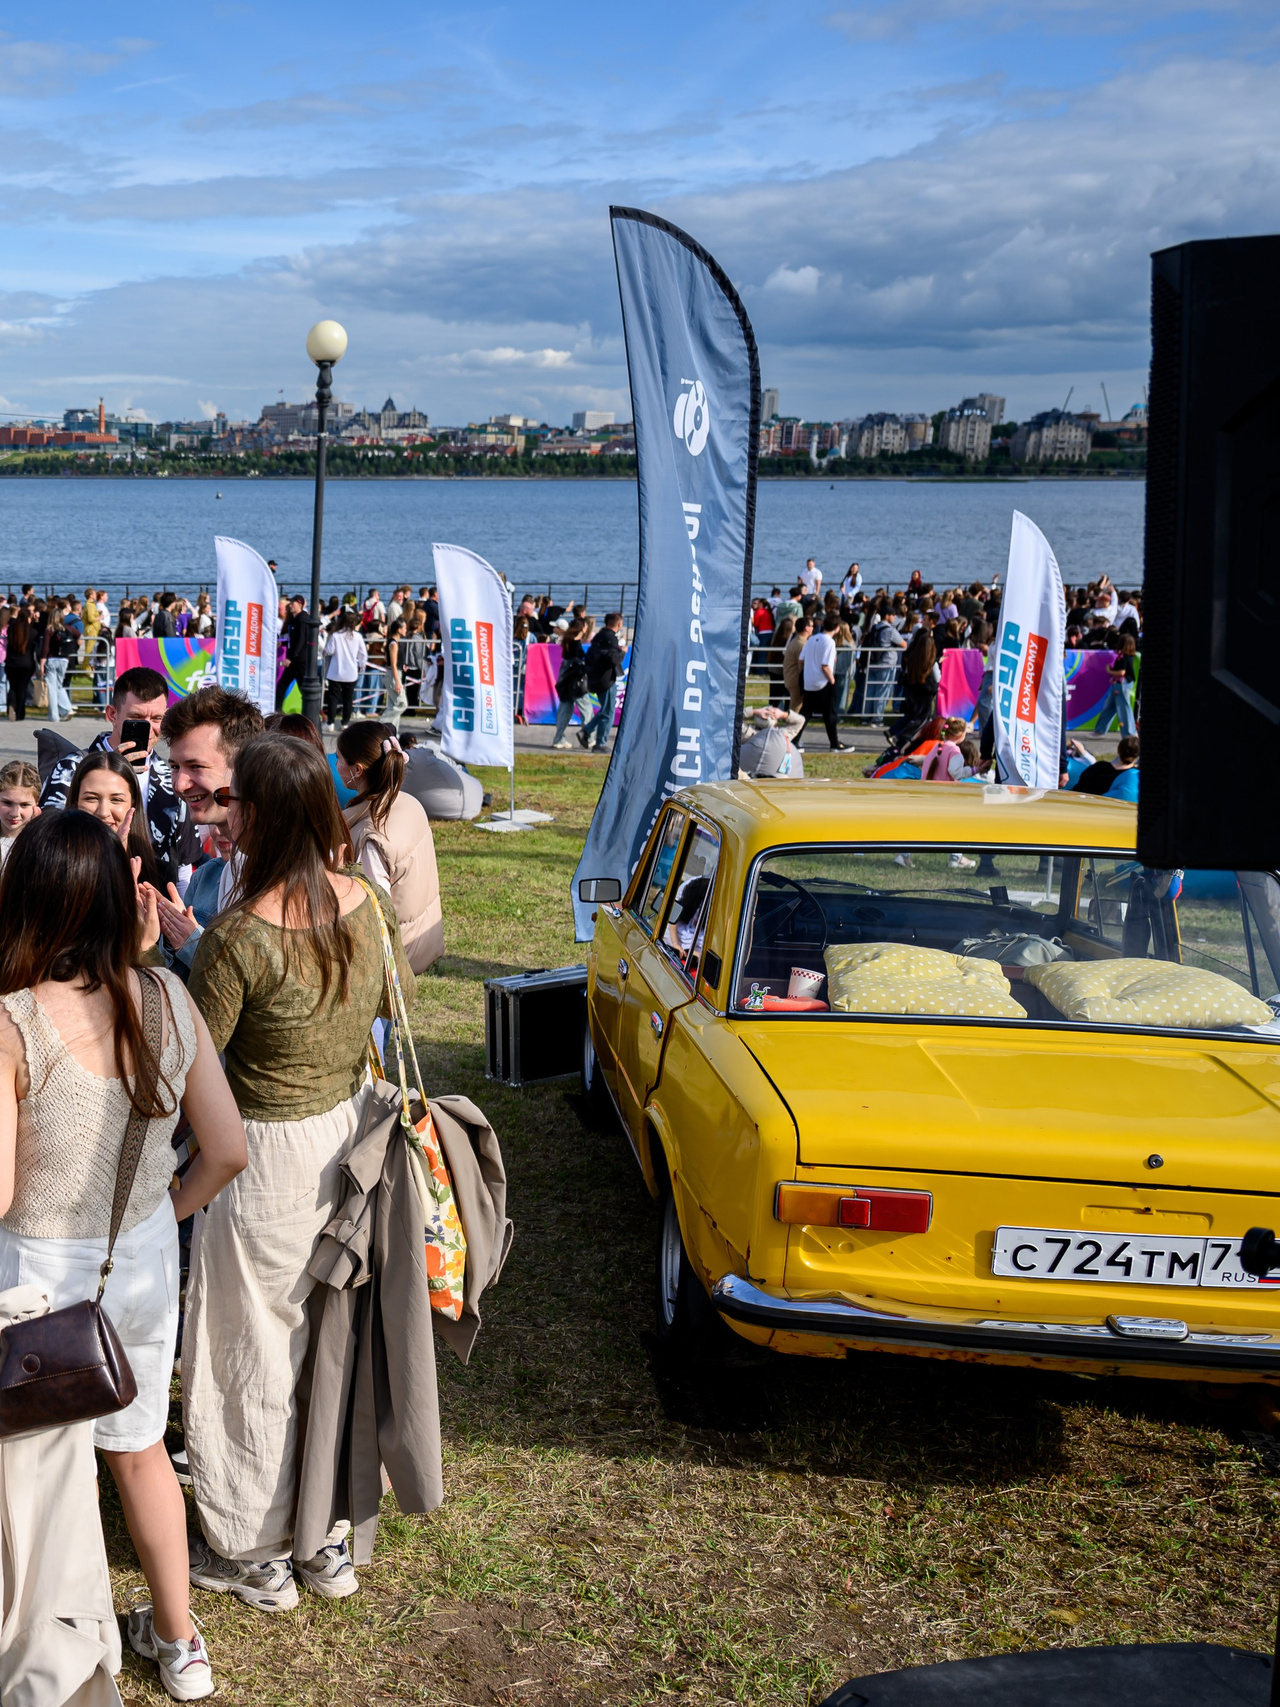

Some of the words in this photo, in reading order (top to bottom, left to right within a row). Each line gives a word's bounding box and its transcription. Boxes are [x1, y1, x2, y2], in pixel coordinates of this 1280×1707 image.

[250, 607, 259, 653] КАЖДОМУ
[479, 626, 491, 682] КАЖДОМУ
[185, 669, 217, 692] fe
[450, 618, 474, 732] СИБУР
[1022, 639, 1038, 716] КАЖДОМУ
[1221, 1271, 1257, 1283] RUS
